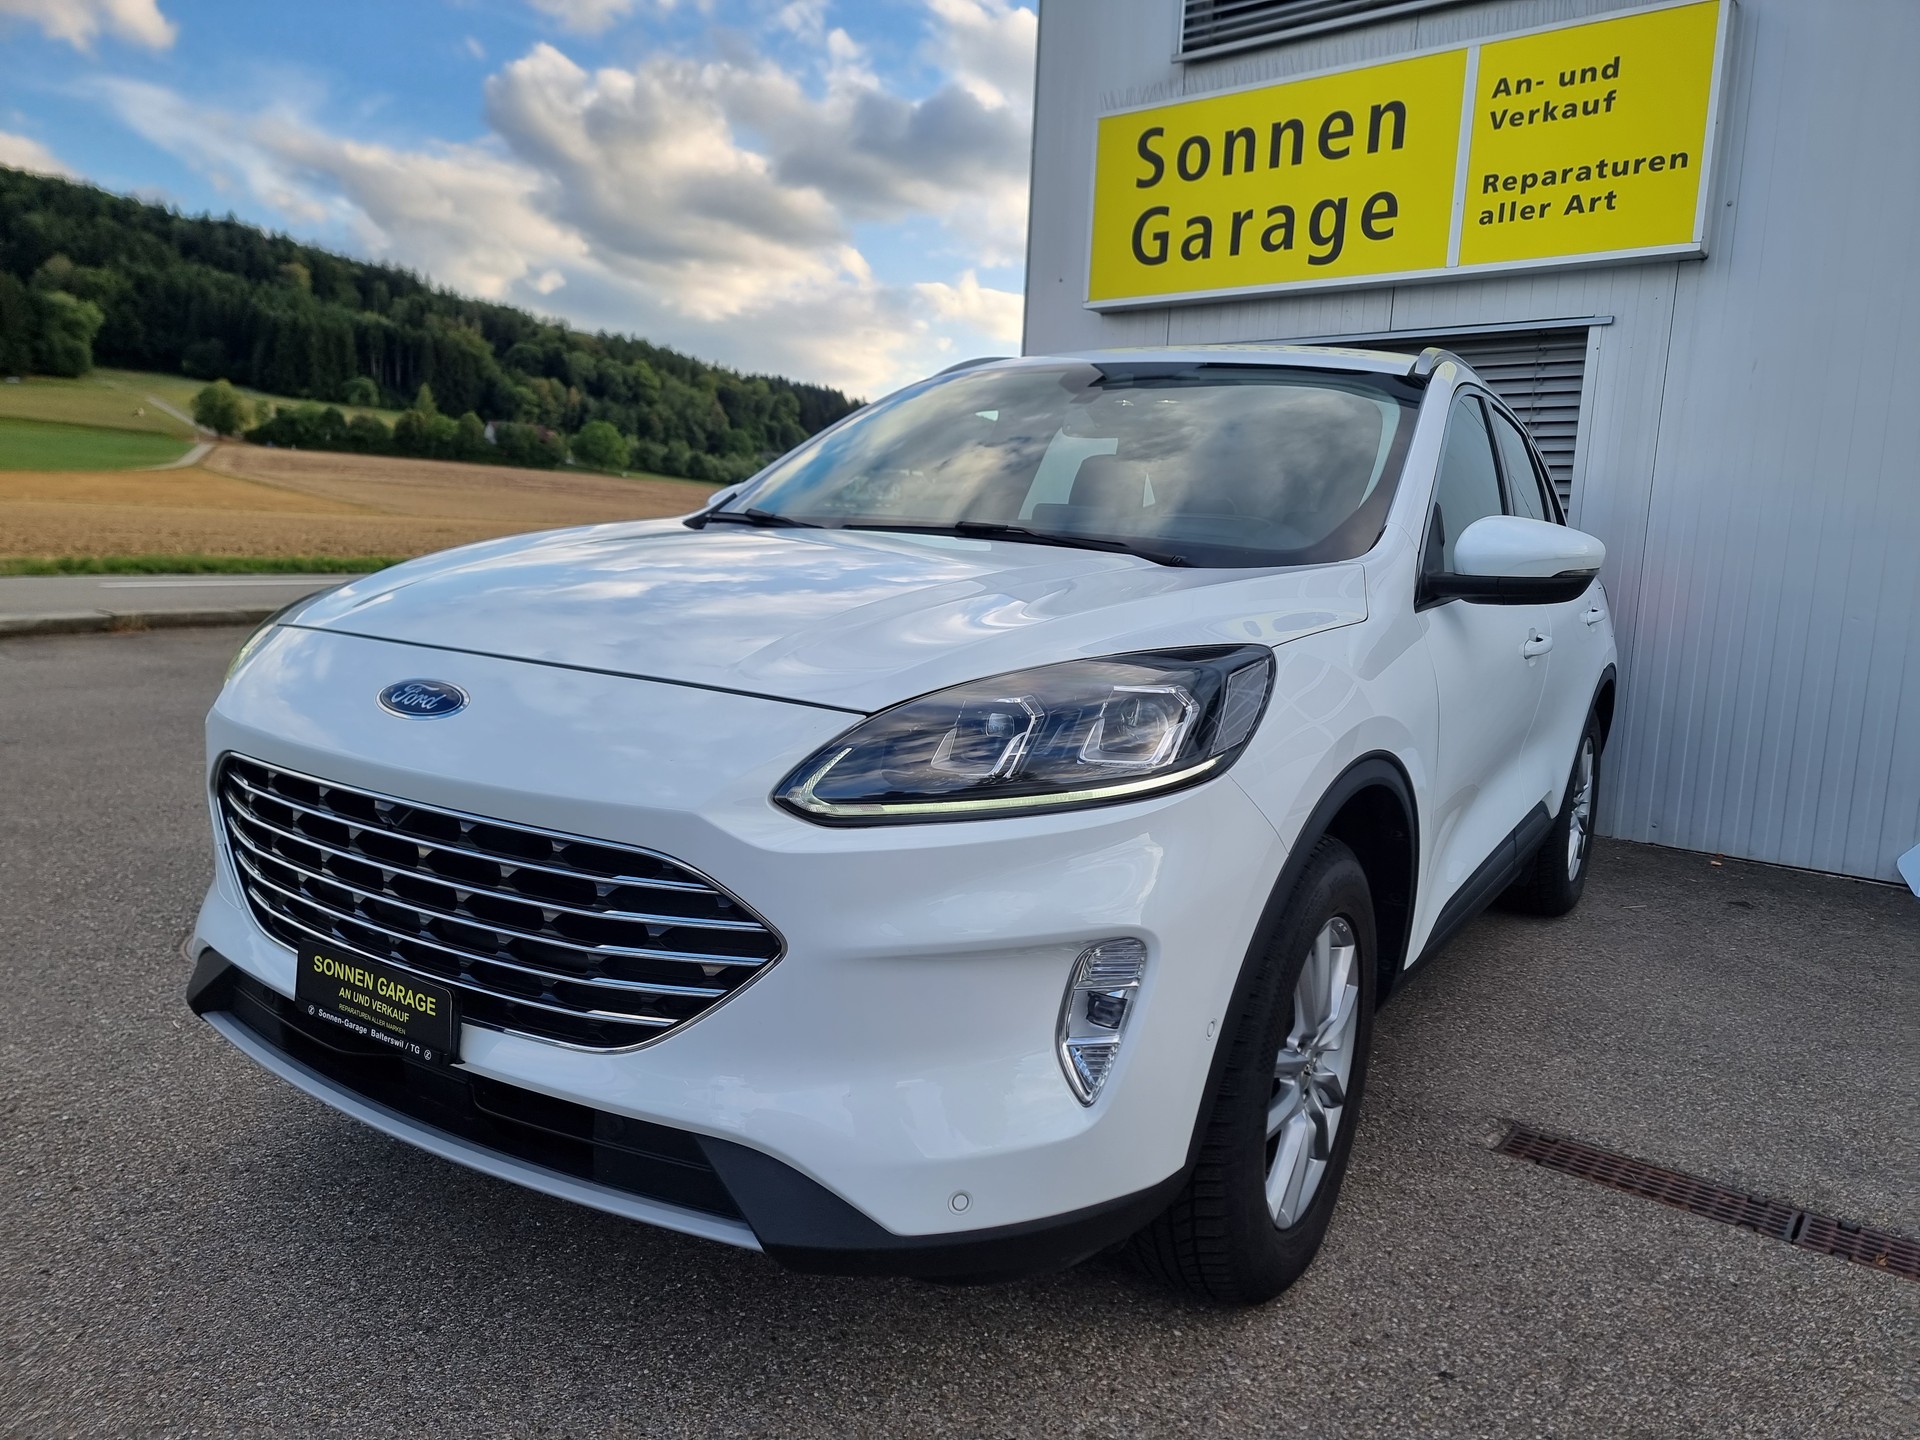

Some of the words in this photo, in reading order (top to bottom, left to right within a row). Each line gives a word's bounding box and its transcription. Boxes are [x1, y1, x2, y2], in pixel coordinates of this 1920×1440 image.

[1491, 77, 1545, 99] An-
[1558, 55, 1621, 87] und
[1489, 89, 1617, 130] Verkauf
[1135, 100, 1407, 188] Sonnen
[1482, 152, 1689, 195] Reparaturen
[1131, 191, 1399, 266] Garage
[1478, 199, 1552, 226] aller
[1563, 190, 1617, 216] Art
[391, 684, 447, 709] Ford
[313, 955, 374, 990] SONNEN
[377, 977, 436, 1016] GARAGE
[338, 986, 350, 1000] AN
[353, 991, 370, 1007] UND
[372, 999, 410, 1023] VERKAUF
[318, 1008, 367, 1034] Sonnen-Garage
[370, 1029, 404, 1049] Balterswil
[410, 1043, 420, 1055] TG
[338, 1003, 371, 1022] REPARATUREN
[371, 1016, 386, 1027] ALLER
[386, 1021, 406, 1035] MARKEN
